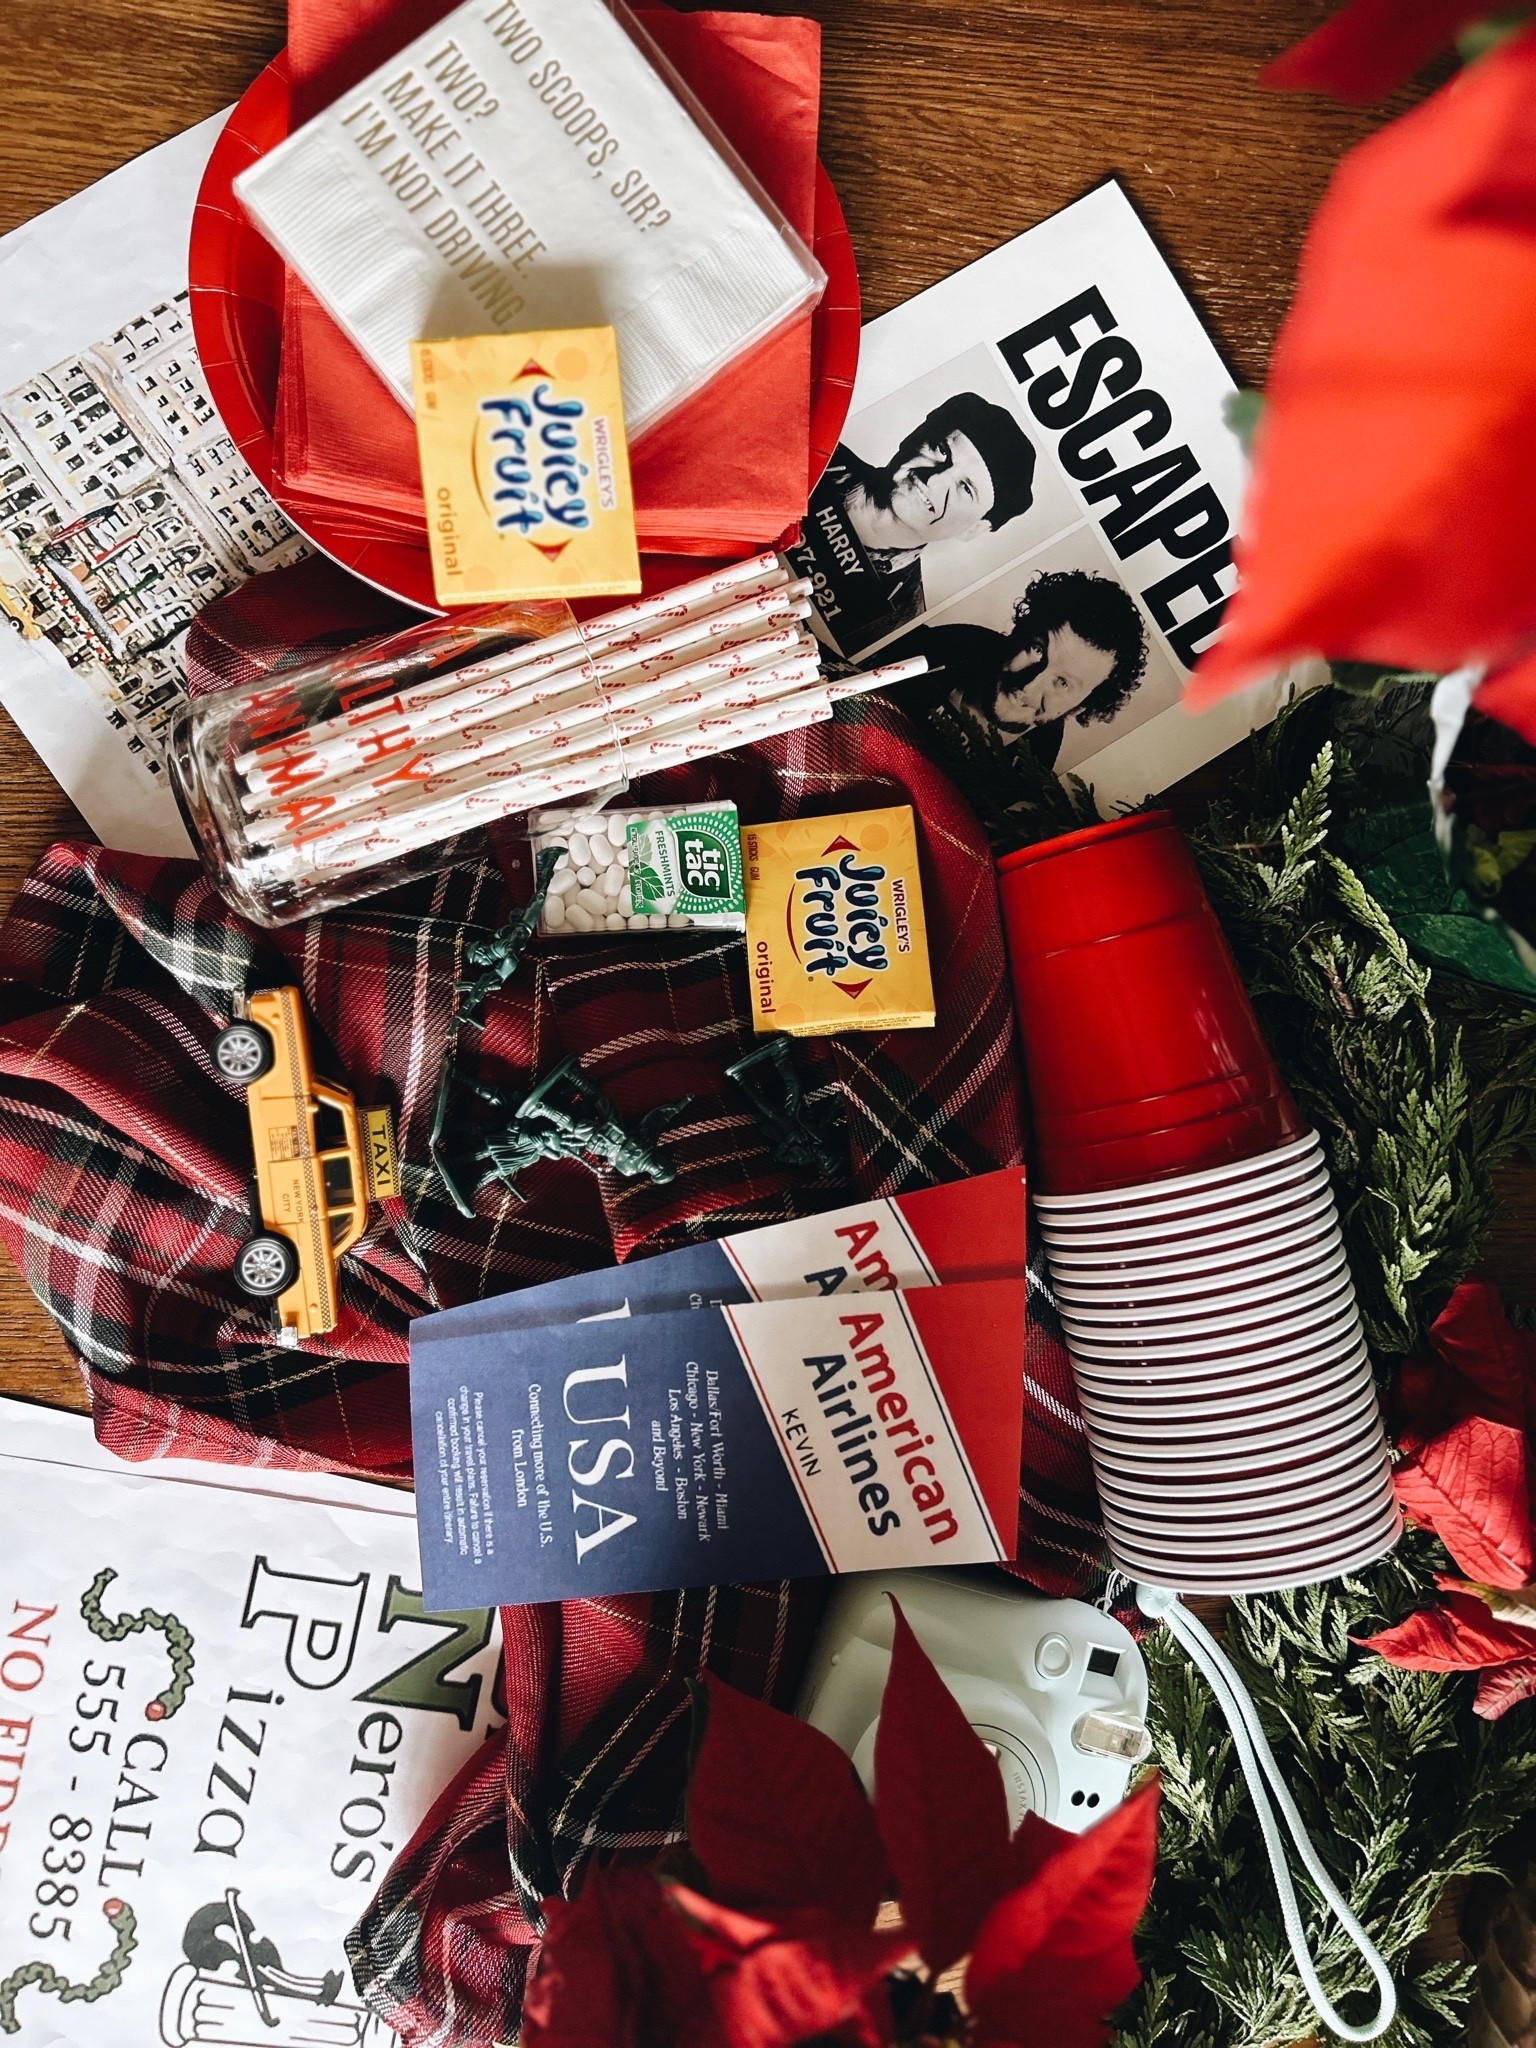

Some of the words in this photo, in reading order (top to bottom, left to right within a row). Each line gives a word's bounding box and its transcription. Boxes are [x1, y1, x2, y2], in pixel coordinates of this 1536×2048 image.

[425, 40, 499, 123] TWO?
[484, 0, 542, 64] TWO
[528, 60, 619, 179] SCOOPS,
[610, 170, 671, 232] SIR?
[342, 102, 397, 158] I'M
[380, 152, 442, 214] NOT
[382, 71, 461, 160] MAKE
[444, 152, 484, 188] IT
[467, 180, 547, 279] THREE.
[482, 399, 544, 534] Fruit
[532, 384, 589, 528] Juicy
[594, 418, 614, 509] WRIGLEY'S
[436, 487, 462, 576] original
[816, 506, 864, 576] HARRY
[240, 684, 346, 850] ANIMAL
[655, 830, 675, 897] FRESHMINTS
[684, 838, 704, 886] tac
[702, 848, 724, 887] tic
[748, 841, 758, 861] STICKS
[796, 866, 848, 976] Fruit
[840, 854, 888, 970] Juicy
[892, 879, 910, 952] WRIGLEY'S
[756, 941, 776, 1014] original
[292, 1180, 300, 1198] NEW
[372, 1125, 390, 1186] TAXI
[282, 1193, 291, 1213] CITY
[295, 1199, 304, 1223] YORK
[528, 1384, 544, 1448] Connecting
[668, 1388, 681, 1411] Los
[685, 1362, 700, 1409] Chicago
[706, 1370, 722, 1437] Dallas/Fort
[476, 1421, 487, 1446] cancel
[512, 1429, 525, 1458] from
[562, 1354, 637, 1564] USA
[651, 1420, 665, 1441] and
[668, 1414, 685, 1460] Angeles
[690, 1422, 704, 1449] New
[712, 1442, 726, 1479] Worth
[781, 1408, 822, 1477] KEVIN
[802, 1354, 900, 1536] Airlines
[839, 1313, 958, 1545] American
[461, 1425, 472, 1443] your
[472, 1531, 483, 1556] cancel
[514, 1461, 529, 1507] London
[533, 1451, 545, 1480] more
[536, 1483, 549, 1496] of
[651, 1445, 668, 1491] Beyond
[674, 1477, 689, 1520] Boston
[692, 1452, 706, 1481] York
[537, 1499, 551, 1519] the
[539, 1521, 553, 1548] U.S.
[695, 1494, 711, 1542] Newark
[715, 1493, 729, 1529] Miami
[0, 1599, 58, 1692] NO
[69, 1659, 126, 1756] 555
[194, 1555, 370, 1858] Pizza
[330, 1575, 497, 1882] Nero's
[97, 1732, 168, 1888] CALL
[29, 1813, 92, 1942] 8385
